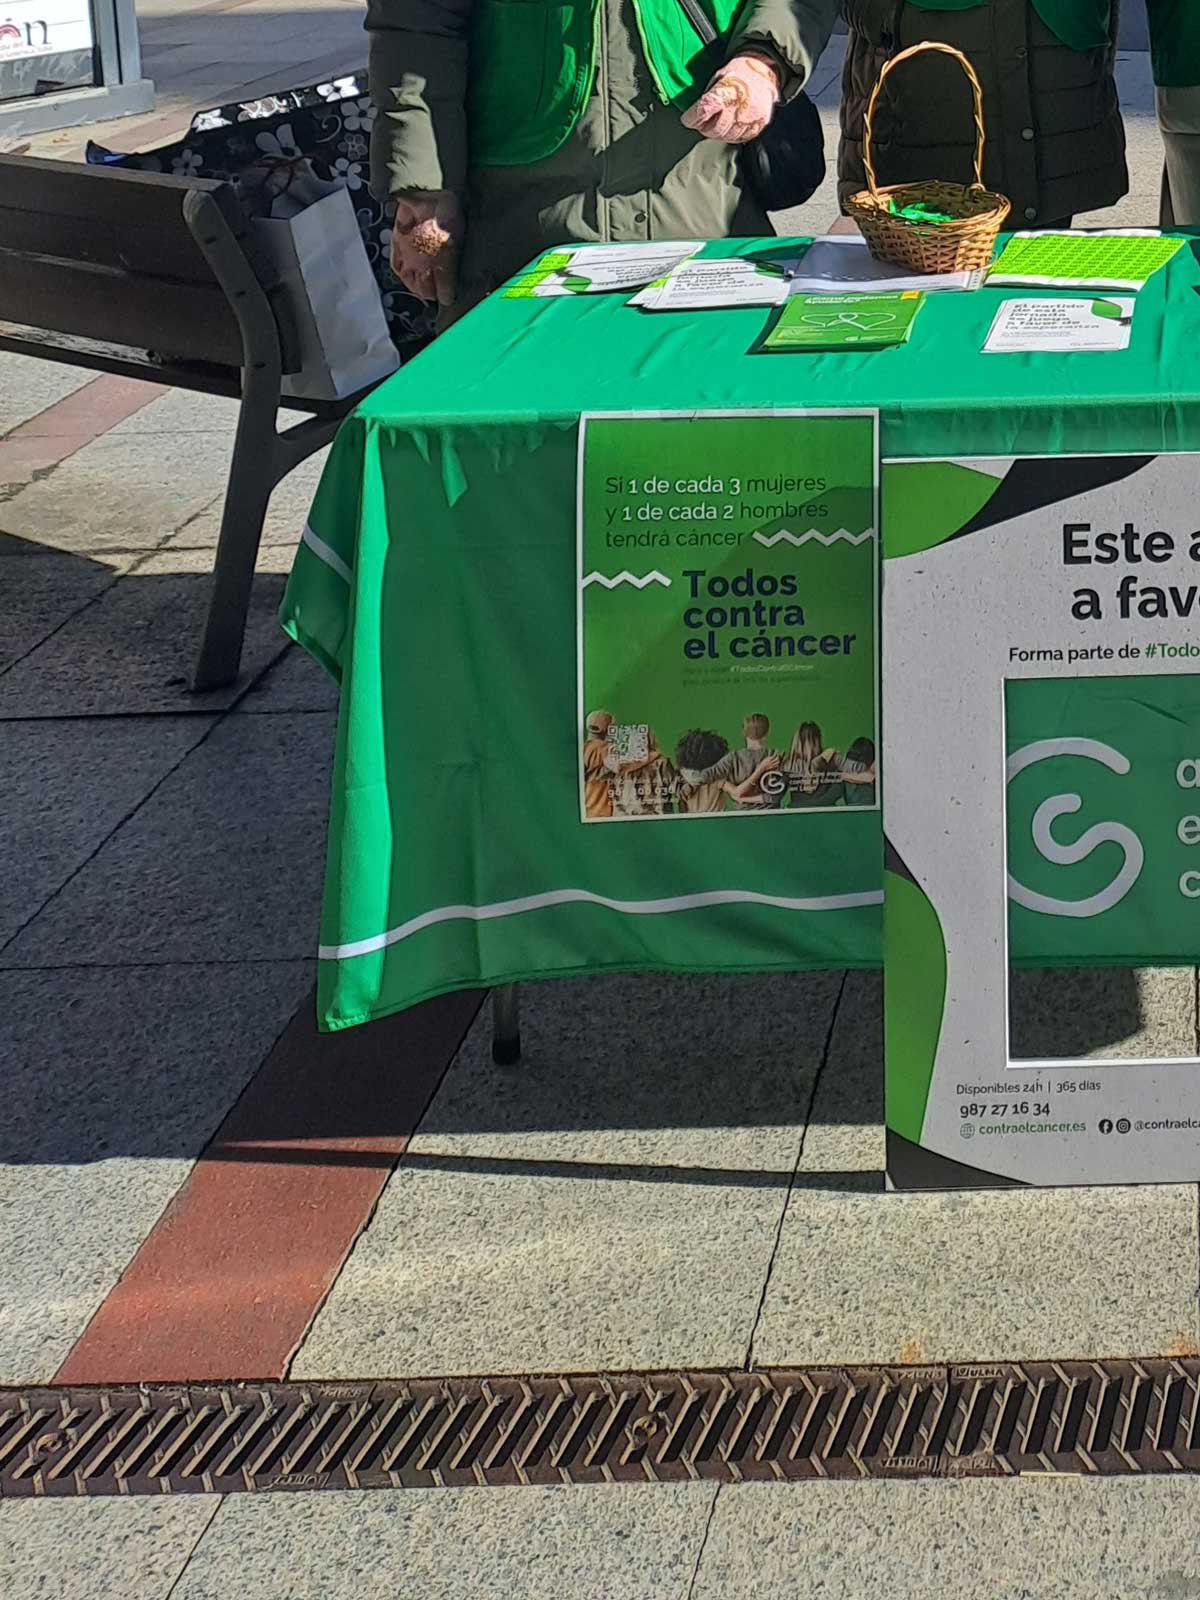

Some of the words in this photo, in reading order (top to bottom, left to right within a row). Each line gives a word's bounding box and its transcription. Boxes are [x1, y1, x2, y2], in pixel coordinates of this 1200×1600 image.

[605, 476, 623, 494] Si
[628, 479, 637, 494] 1
[643, 475, 670, 493] de
[675, 475, 724, 493] cada
[729, 478, 741, 495] 3
[747, 475, 826, 495] mujeres
[605, 506, 619, 525] y
[622, 506, 632, 521] 1
[637, 502, 664, 520] de
[668, 502, 717, 520] cada
[722, 505, 734, 520] 2
[740, 501, 829, 519] hombres
[605, 530, 670, 548] tendrá
[675, 529, 745, 547] cáncer
[1062, 522, 1175, 566] Este
[682, 568, 798, 598] Todos
[682, 600, 805, 628] contra
[1070, 586, 1102, 621] a
[683, 630, 720, 660] el
[729, 629, 857, 659] cáncer
[1009, 647, 1063, 662] Forma
[1067, 644, 1114, 664] parte
[1118, 643, 1141, 659] de
[956, 1082, 1020, 1097] Disponibles
[1022, 1080, 1043, 1094] 24h
[1056, 1081, 1077, 1094] 365
[960, 1102, 987, 1118] 987
[991, 1103, 1008, 1118] 27
[1012, 1101, 1029, 1115] 16
[1033, 1102, 1050, 1116] 34
[978, 1120, 1087, 1136] contraelcancer.es
